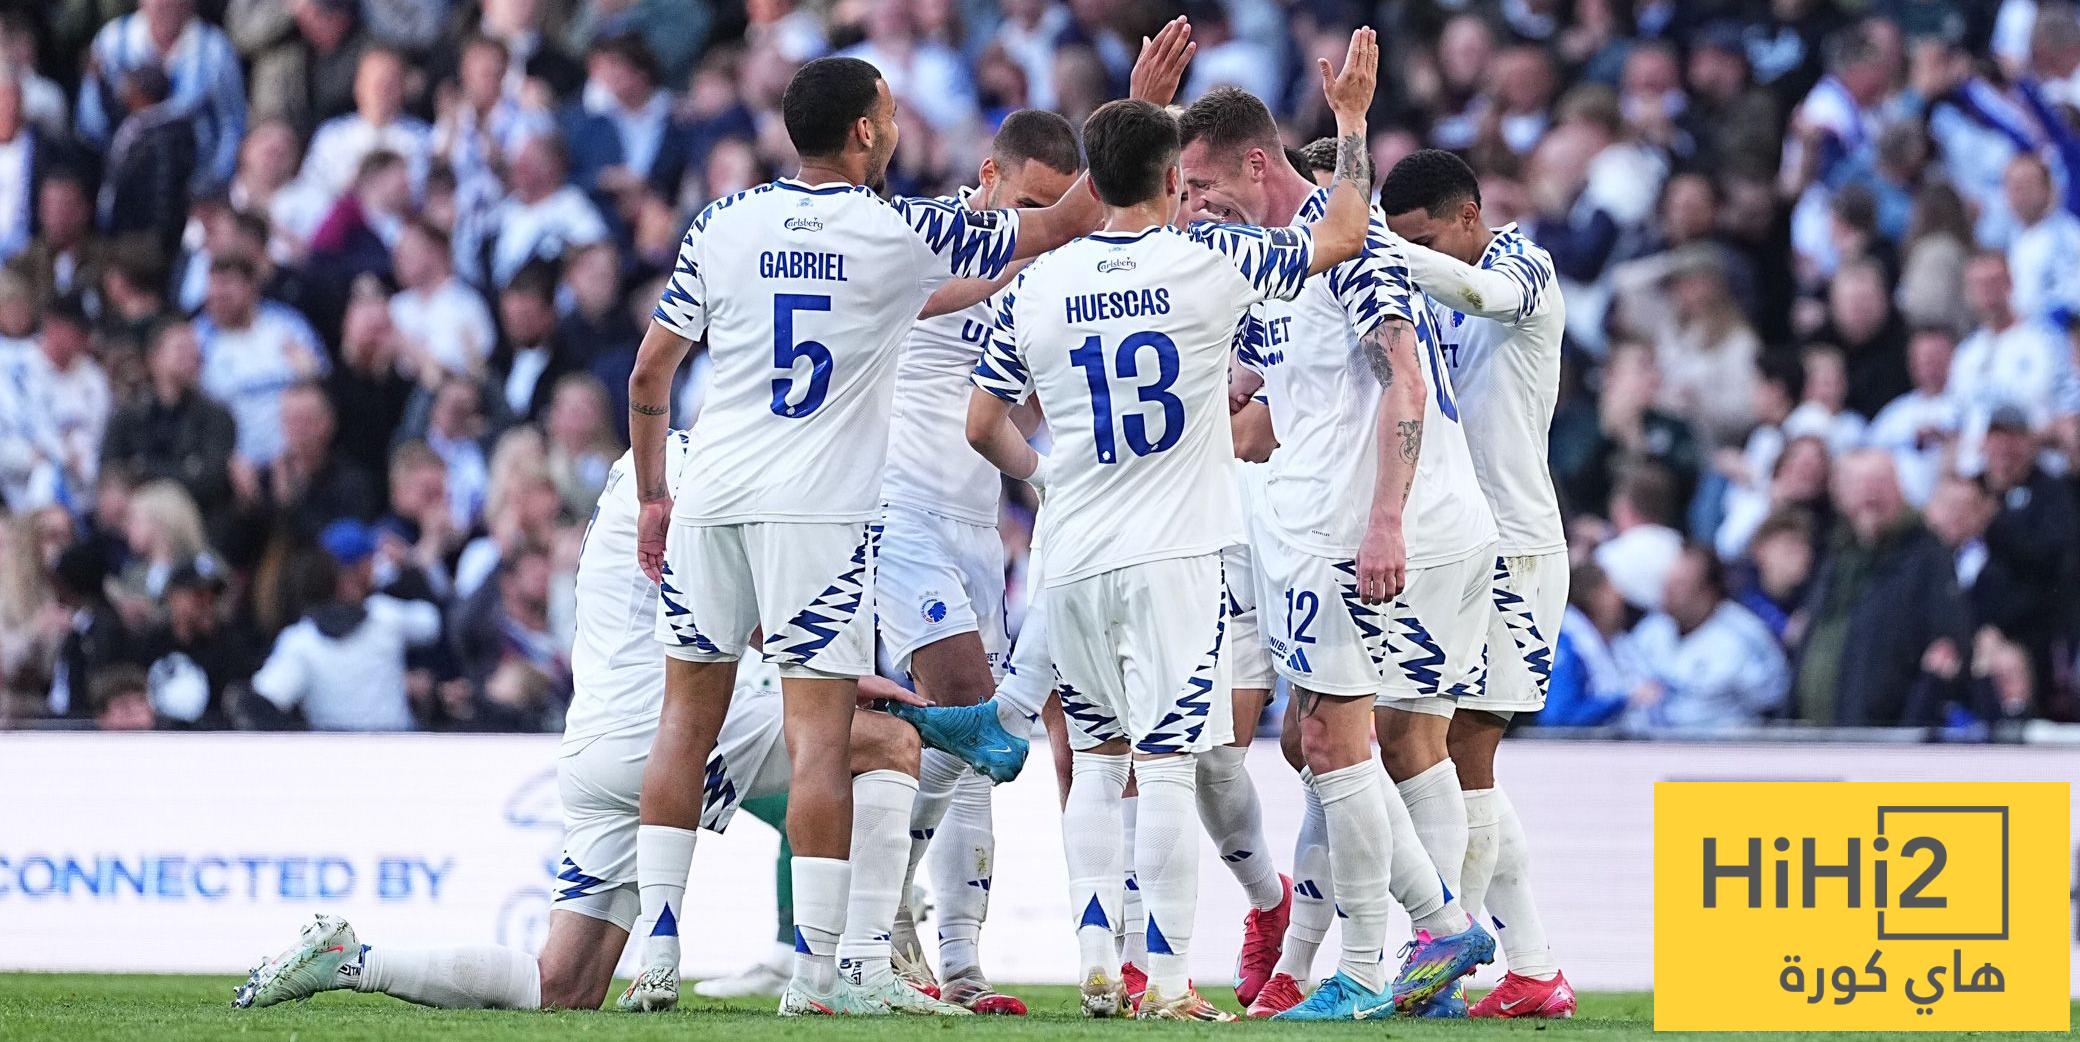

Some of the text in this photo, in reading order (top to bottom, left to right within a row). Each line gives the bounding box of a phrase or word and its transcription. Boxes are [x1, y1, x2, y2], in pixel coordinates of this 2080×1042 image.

[783, 216, 824, 232] Carlsberg
[759, 250, 848, 282] GABRIEL
[1097, 256, 1137, 273] Carlsberg
[1065, 287, 1171, 324] HUESCAS
[770, 293, 834, 419] 5
[1069, 330, 1186, 465] 13
[1284, 587, 1319, 645] 12
[0, 854, 455, 901] ONNECTED BY
